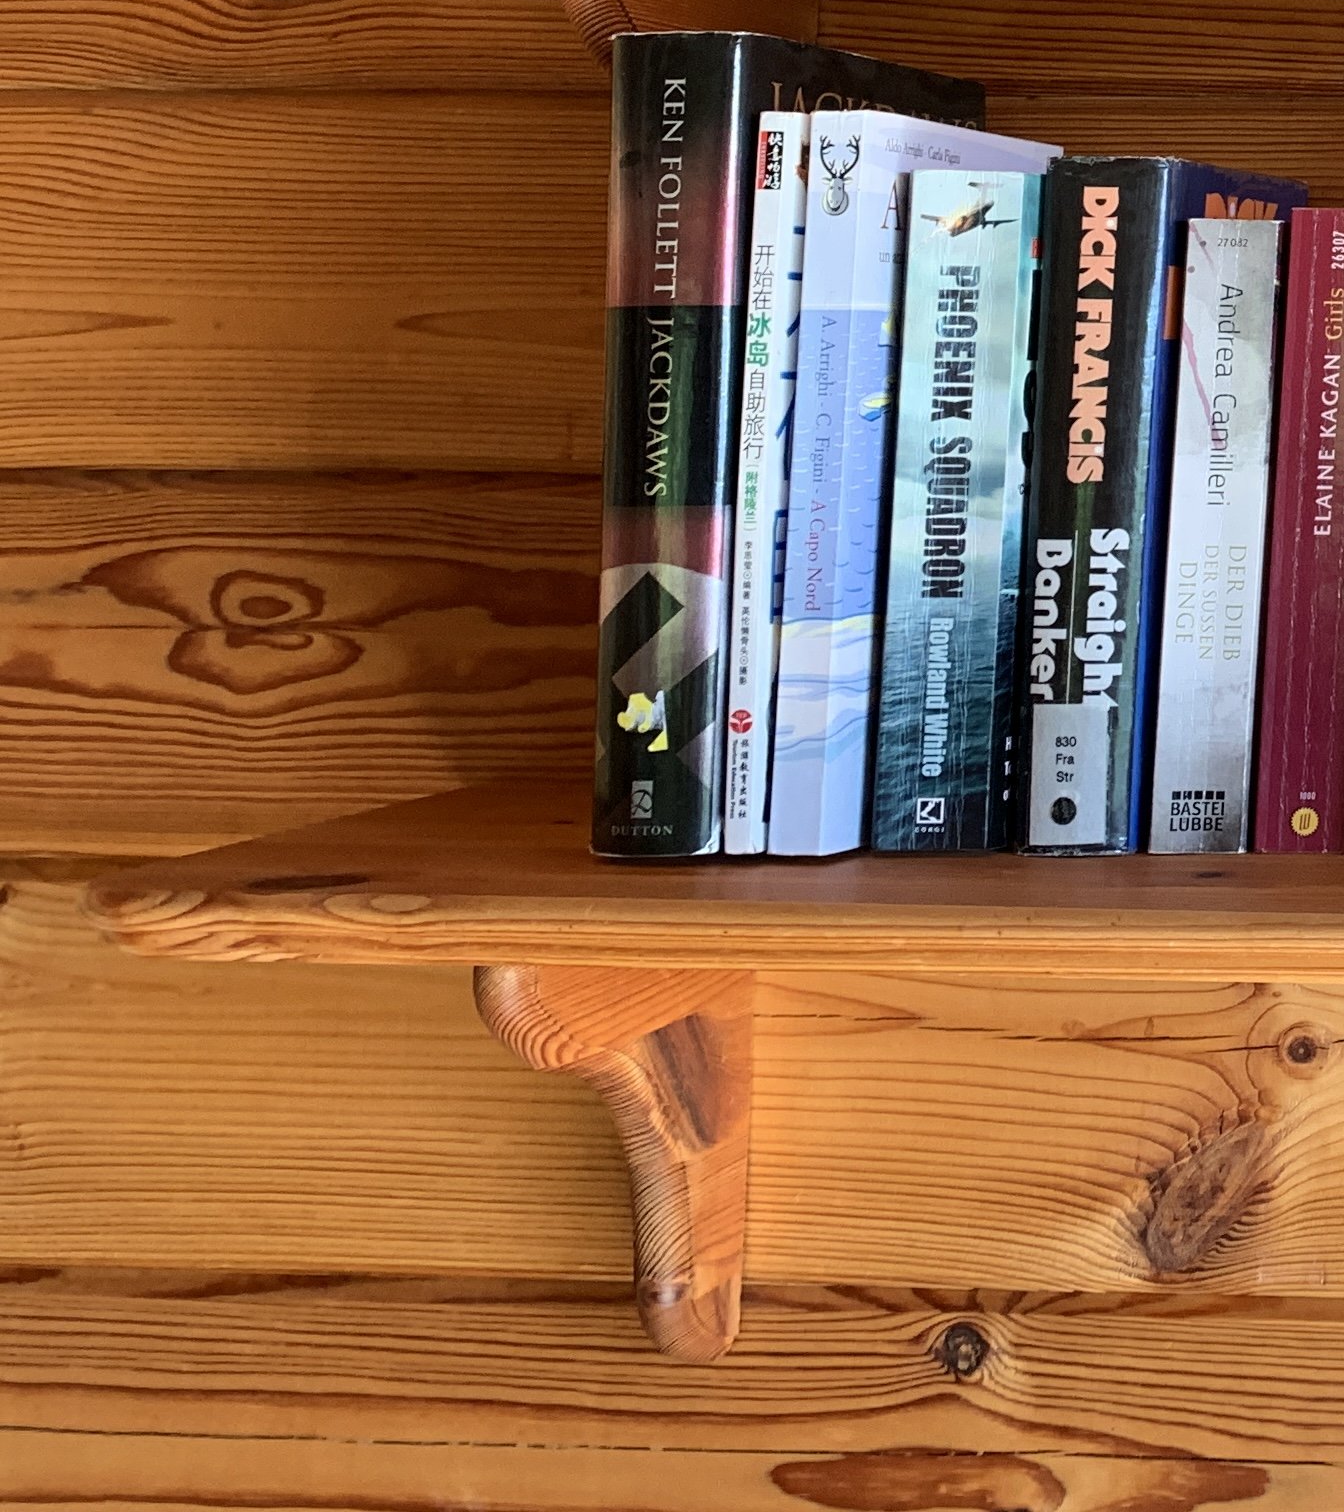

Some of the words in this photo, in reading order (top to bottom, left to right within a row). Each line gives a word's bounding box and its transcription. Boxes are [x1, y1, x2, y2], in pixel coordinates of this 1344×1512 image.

[661, 77, 686, 142] KEN
[885, 138, 901, 153] Aldo
[653, 155, 682, 299] FOLLETT
[1077, 186, 1119, 290] DICK
[821, 315, 837, 333] A.
[932, 264, 980, 422] PHOENIX
[1213, 283, 1244, 379] Andrea
[1323, 287, 1344, 340] Girls
[815, 335, 836, 396] Arrighi
[1066, 297, 1113, 484] FRANCIS
[643, 316, 674, 497] JACKDAWS
[1319, 353, 1341, 440] KAGAN
[810, 437, 830, 488] Figini
[1206, 390, 1237, 507] Camilleri
[811, 500, 827, 513] A
[921, 435, 973, 599] SQUADRON
[1314, 450, 1335, 536] ELAINE
[804, 518, 825, 561] Capo
[1203, 545, 1219, 583] DER
[1226, 545, 1247, 594] DER
[804, 568, 823, 611] Nord
[1028, 539, 1073, 701] Banker
[1175, 562, 1198, 644] DINGE
[924, 617, 954, 706] Rowland
[1222, 604, 1244, 661] DIEB
[921, 712, 950, 778] White
[1055, 736, 1077, 747] 830
[1056, 753, 1075, 765] Fra
[1056, 771, 1074, 782] Str
[611, 824, 673, 836] DUTTON
[1171, 801, 1225, 816] BASTEI
